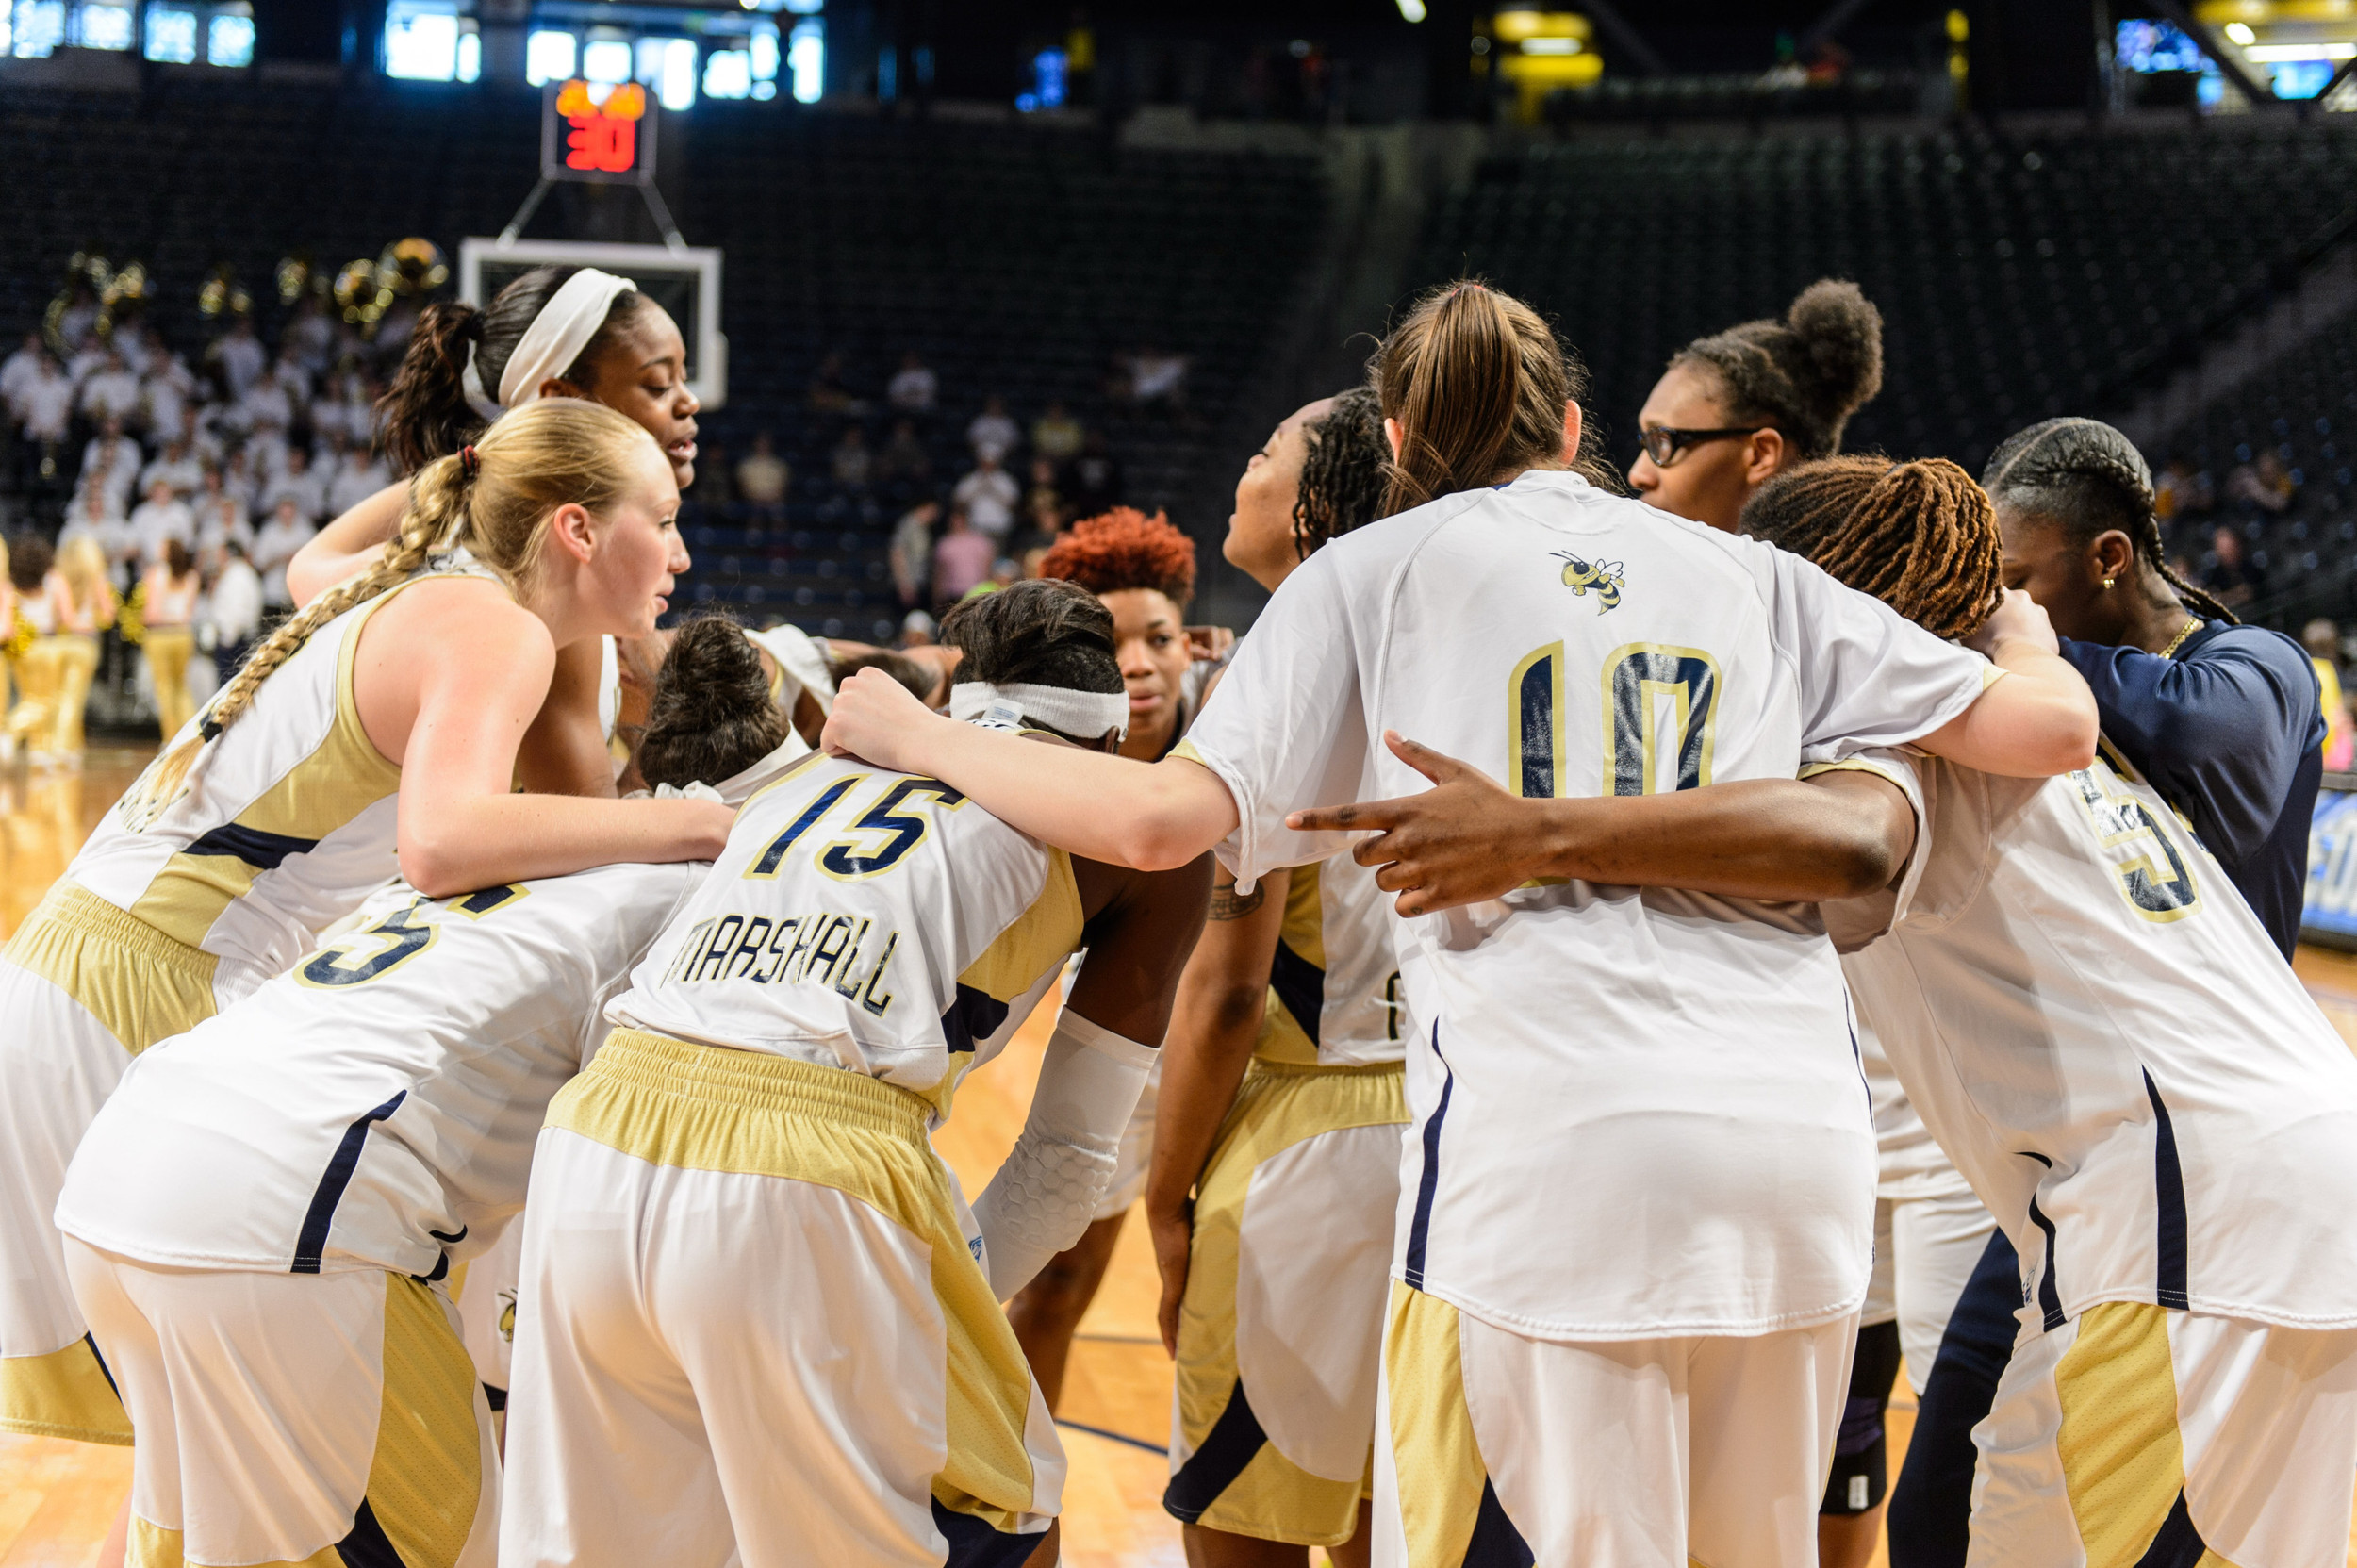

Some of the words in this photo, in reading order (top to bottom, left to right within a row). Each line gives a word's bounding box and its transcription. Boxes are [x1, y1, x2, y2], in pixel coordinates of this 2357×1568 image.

[566, 114, 635, 173] 30
[741, 773, 973, 883] 15
[659, 912, 900, 1019] MARSHALL
